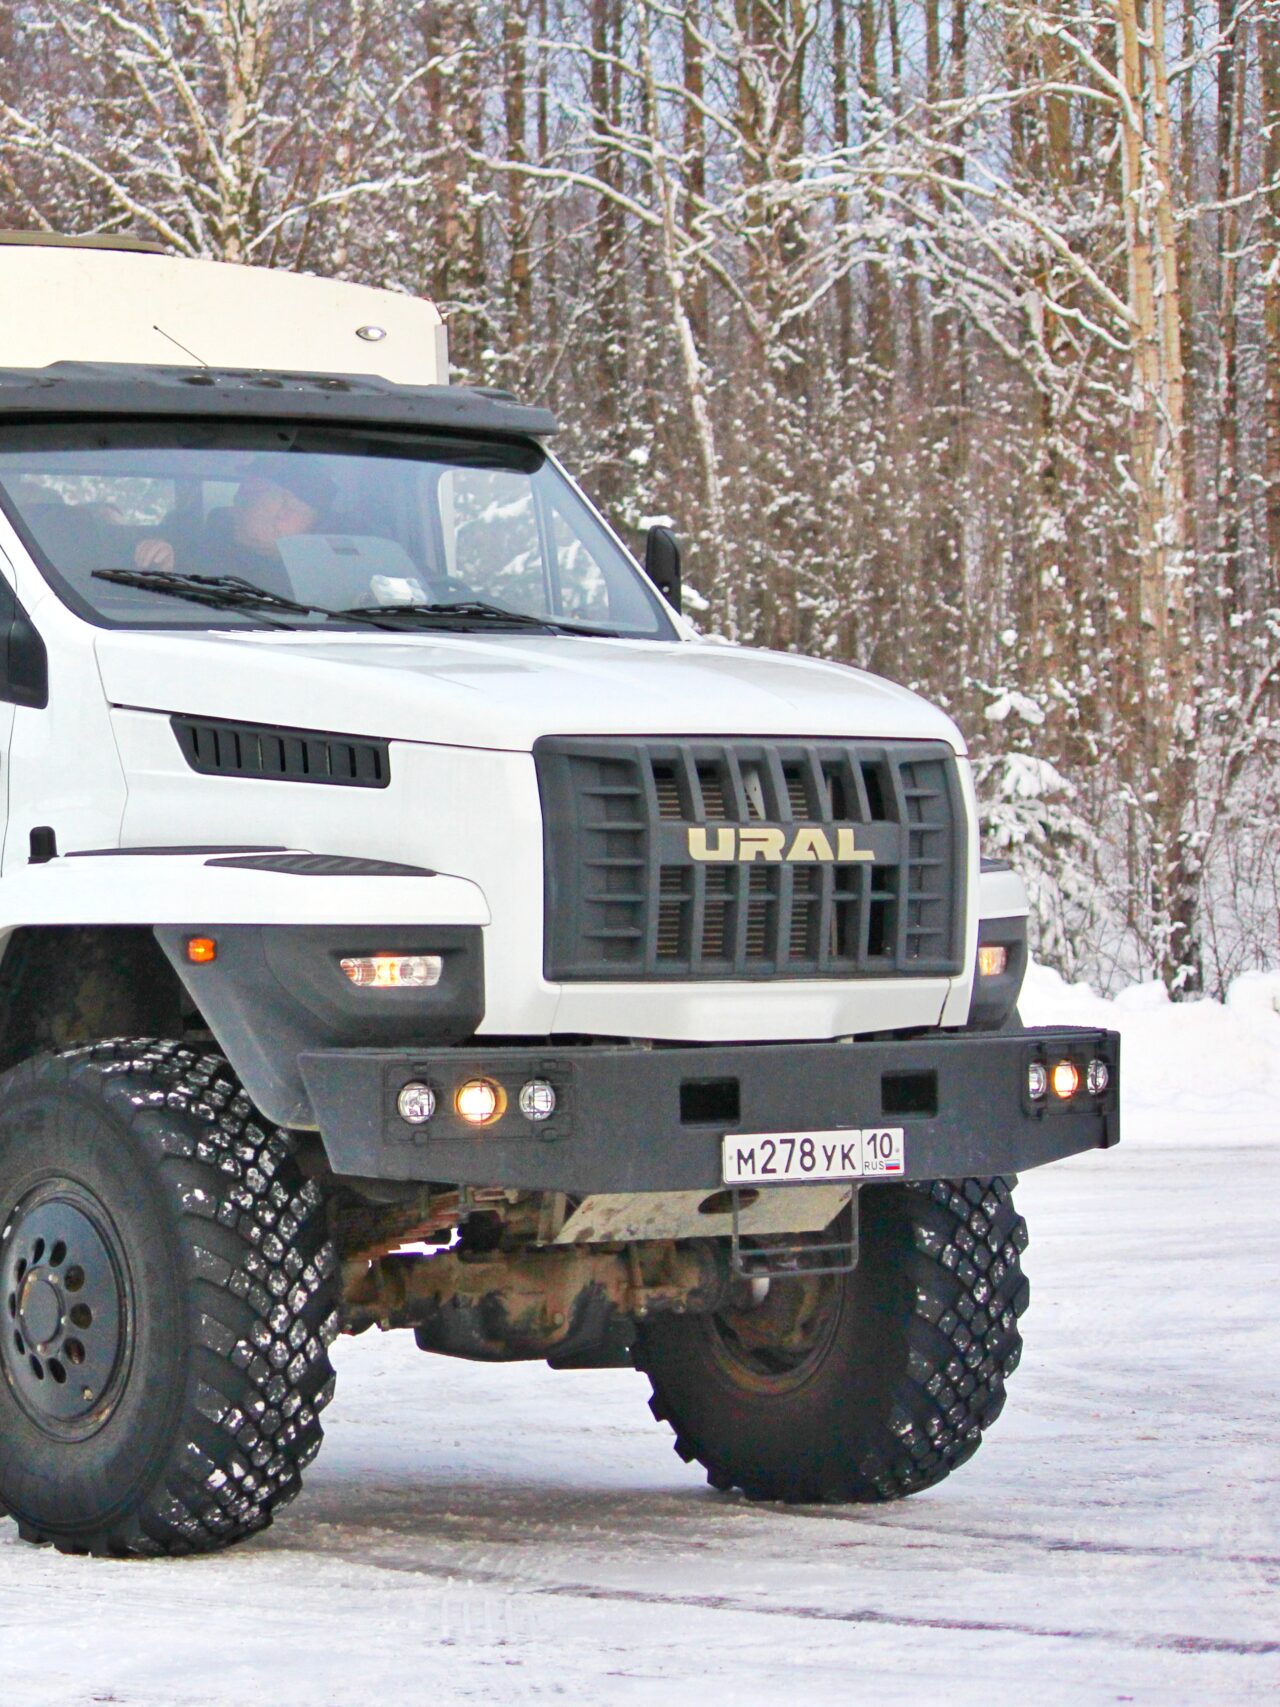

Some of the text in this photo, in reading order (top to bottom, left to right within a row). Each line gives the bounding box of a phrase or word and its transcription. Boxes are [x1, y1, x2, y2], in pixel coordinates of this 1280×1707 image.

[688, 827, 875, 861] URAL
[867, 1132, 893, 1160] 10
[864, 1160, 885, 1171] RUS
